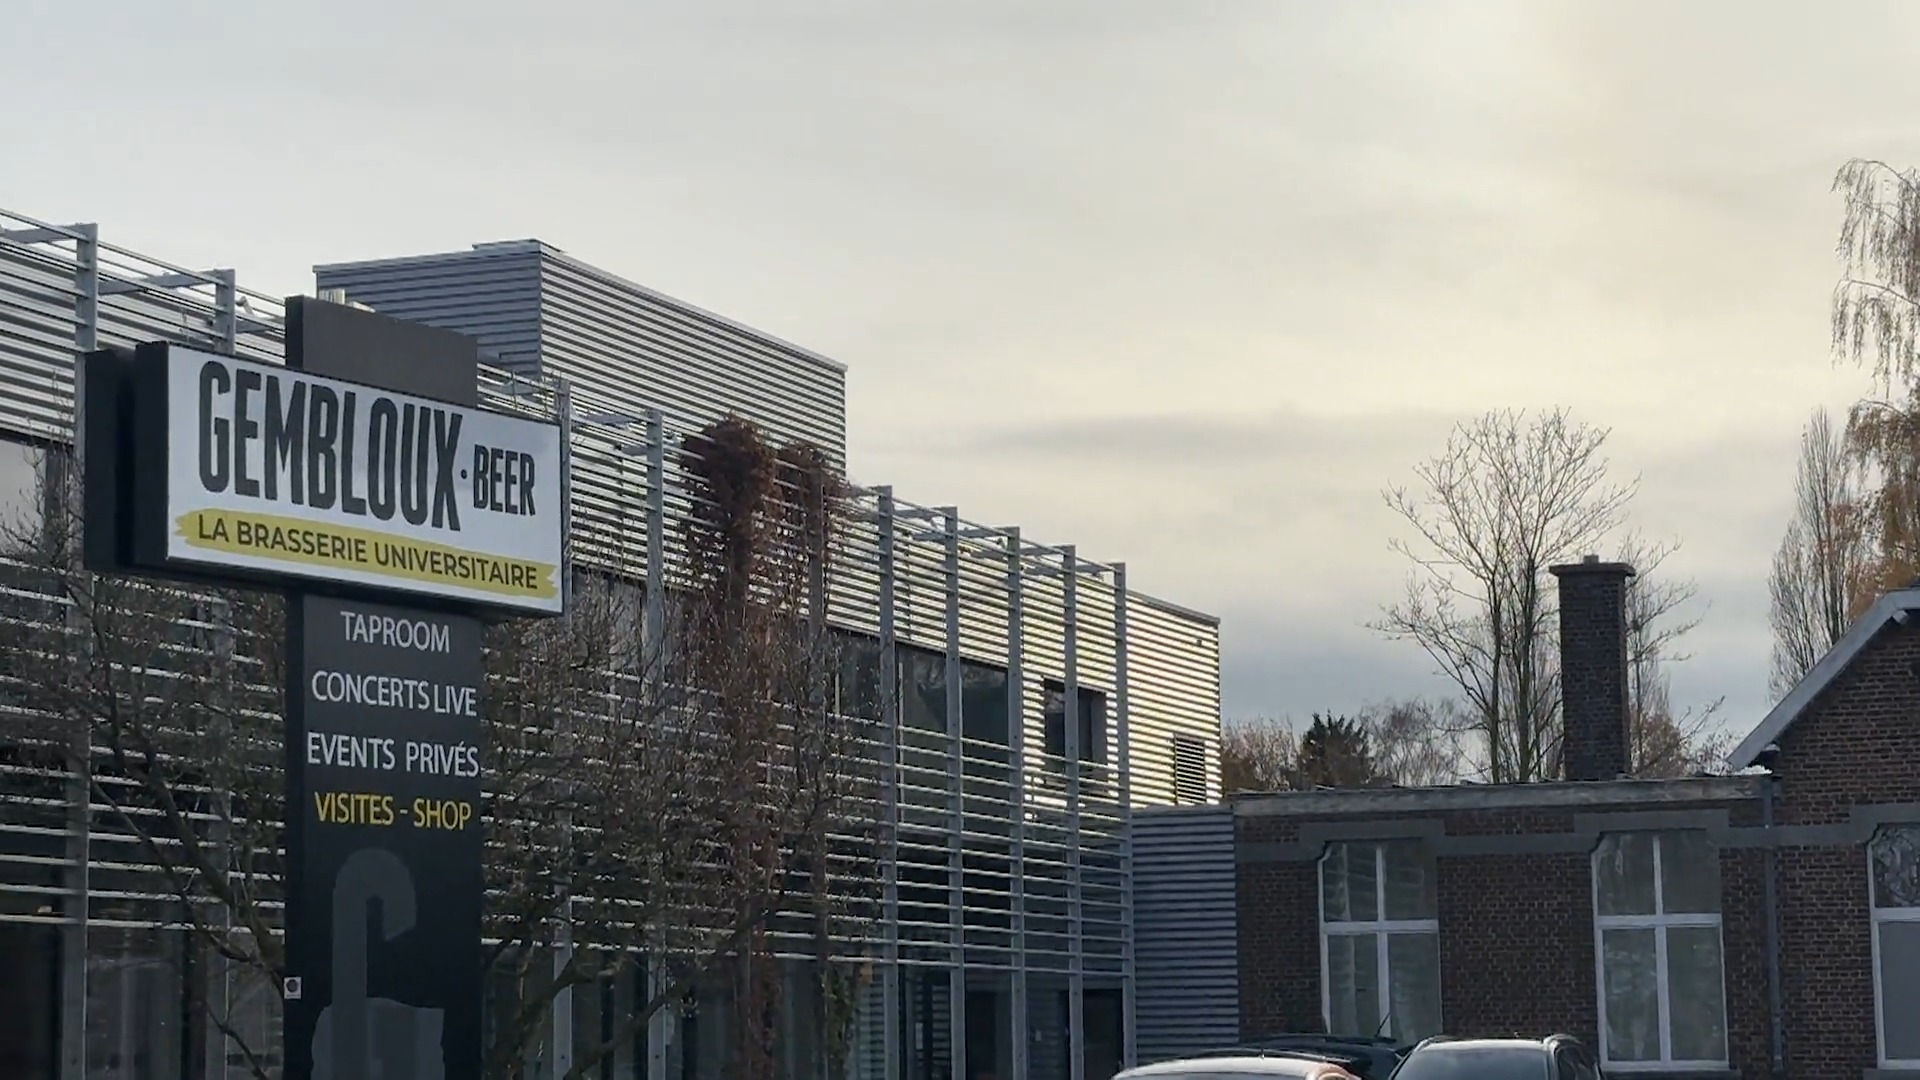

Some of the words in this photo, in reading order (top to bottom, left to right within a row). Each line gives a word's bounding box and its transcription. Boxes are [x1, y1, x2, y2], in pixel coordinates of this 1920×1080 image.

[198, 513, 229, 542] LA
[237, 523, 367, 563] BRASSERIE
[375, 542, 538, 590] UNIVERSITAIRE
[341, 611, 450, 653] TAPROOM
[312, 670, 430, 709] CONCERTS
[434, 685, 477, 716] LIVE
[308, 732, 395, 770] EVENTS
[406, 741, 479, 777] PRIVÉS
[315, 792, 394, 825] VISITES
[413, 799, 471, 830] SHOP
